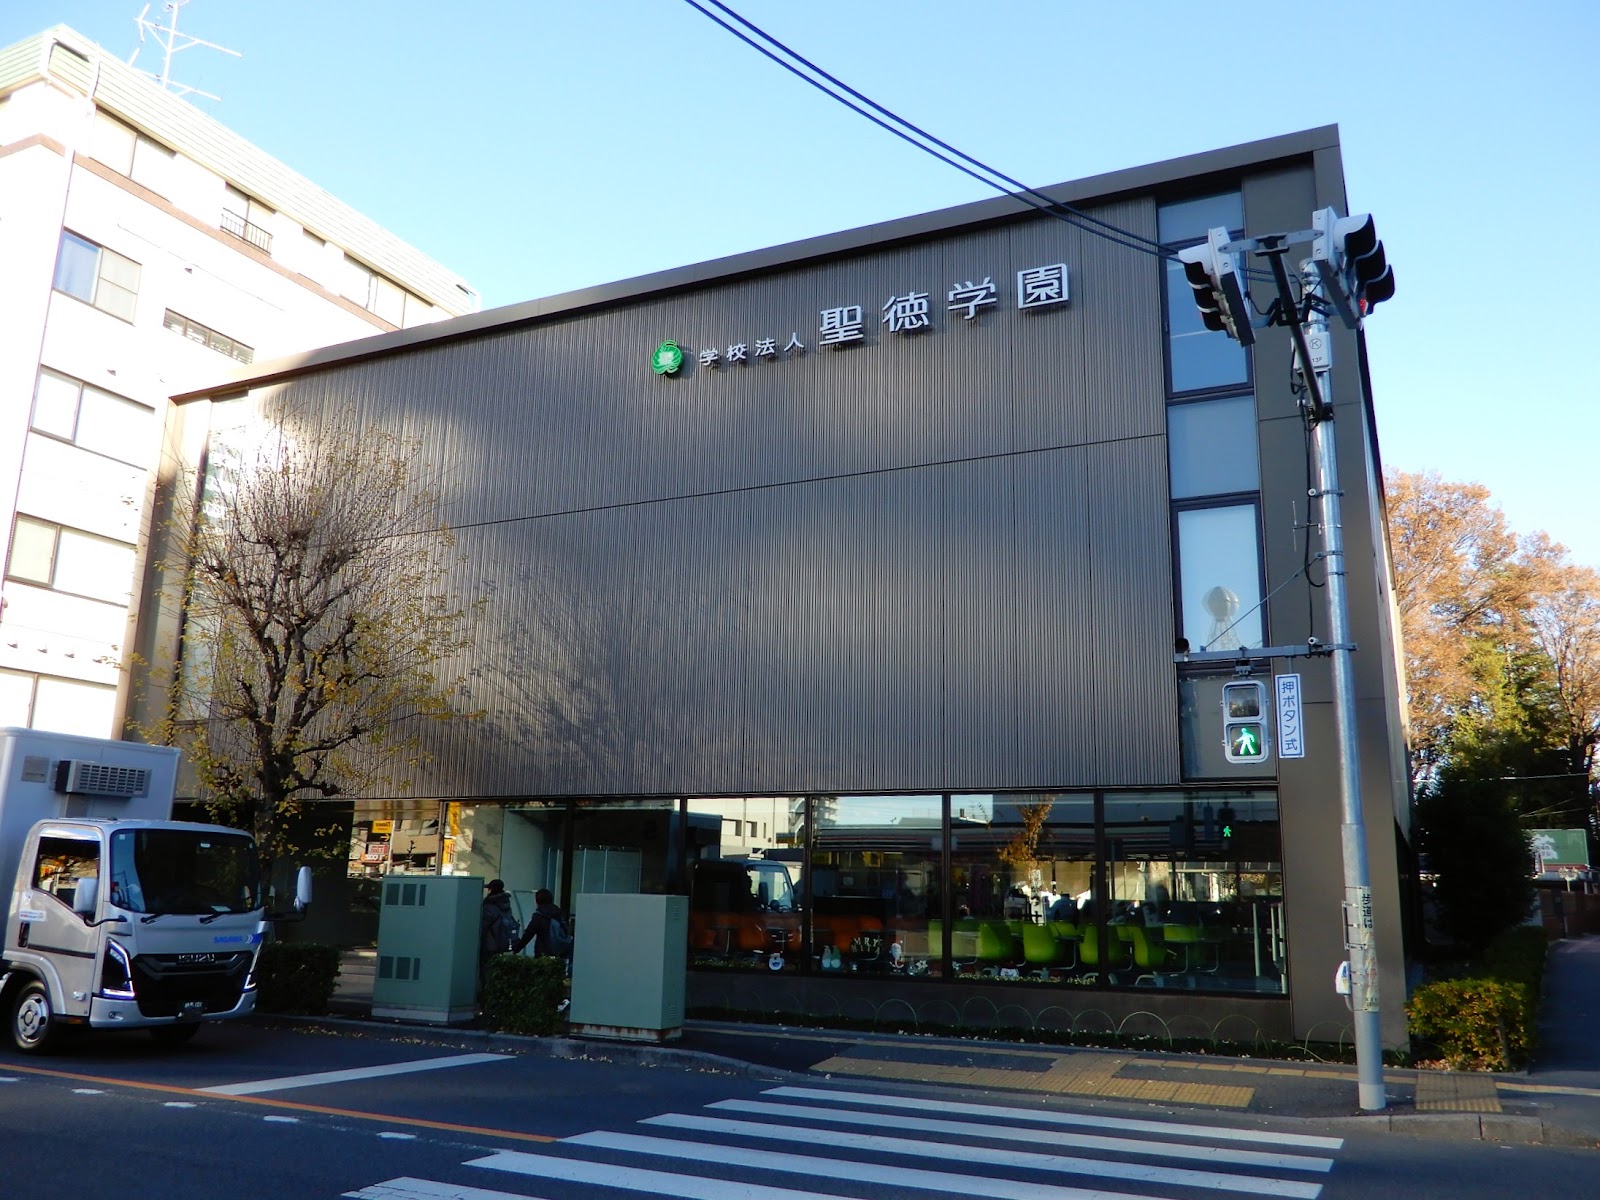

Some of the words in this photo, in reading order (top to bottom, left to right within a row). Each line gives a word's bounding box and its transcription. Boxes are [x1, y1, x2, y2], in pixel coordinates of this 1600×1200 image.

[819, 263, 1069, 345] 聖徳学園
[1281, 681, 1298, 751] 押ボタン式
